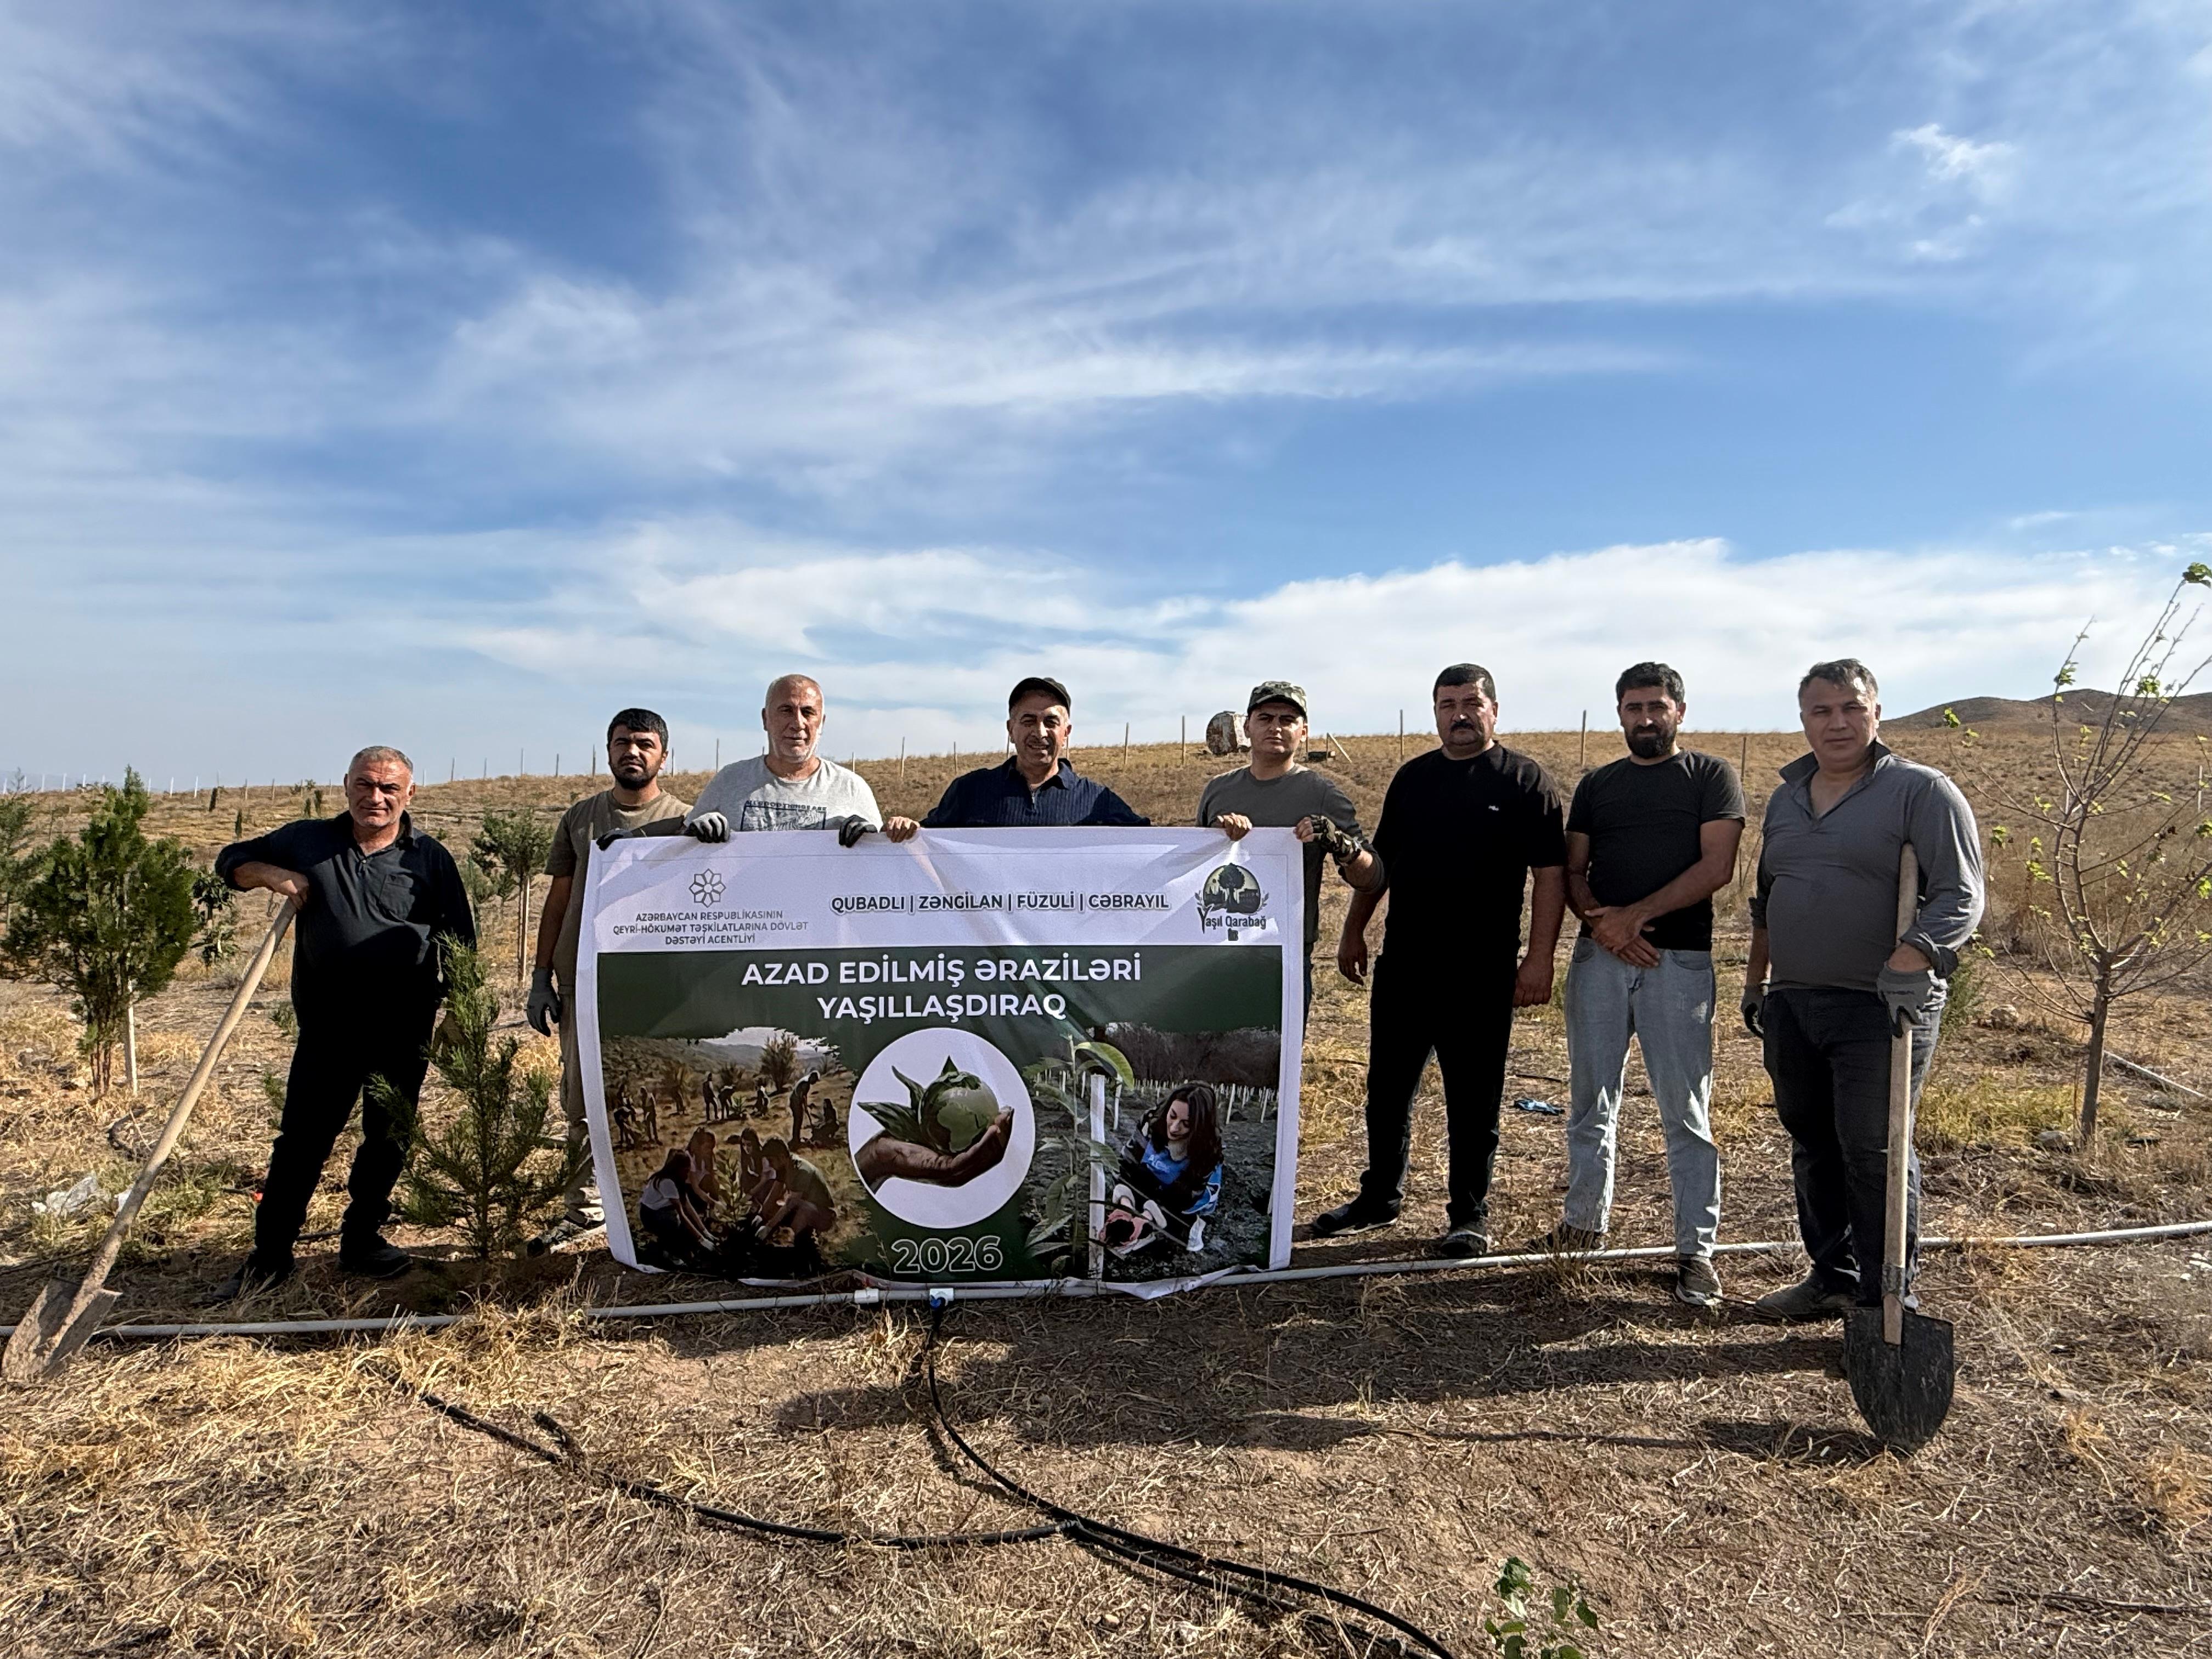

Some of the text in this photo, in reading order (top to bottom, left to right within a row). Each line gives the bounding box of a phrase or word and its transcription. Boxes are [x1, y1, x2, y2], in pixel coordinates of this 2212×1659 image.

[832, 896, 905, 913] QUBADLI
[918, 891, 1003, 909] ZƏNGİLAN
[1017, 891, 1074, 909] FÜZULİ
[1088, 894, 1169, 908] CƏBRAYIL
[635, 909, 783, 922] AZƏRBAYCAN RESPUBLİKASININ
[689, 922, 769, 936] TƏŞKİLATLARINA
[770, 919, 809, 931] DÖVLƏT
[1197, 905, 1266, 934] Yaşıl Qarabağ
[665, 933, 706, 945] DƏSTƏYİ
[742, 952, 1141, 988] AZAD EDİLMİŞ ƏRAZİLƏRİ
[816, 994, 1066, 1025] YAŞILLAŞDIRAQ
[891, 1235, 1003, 1273] 2026
